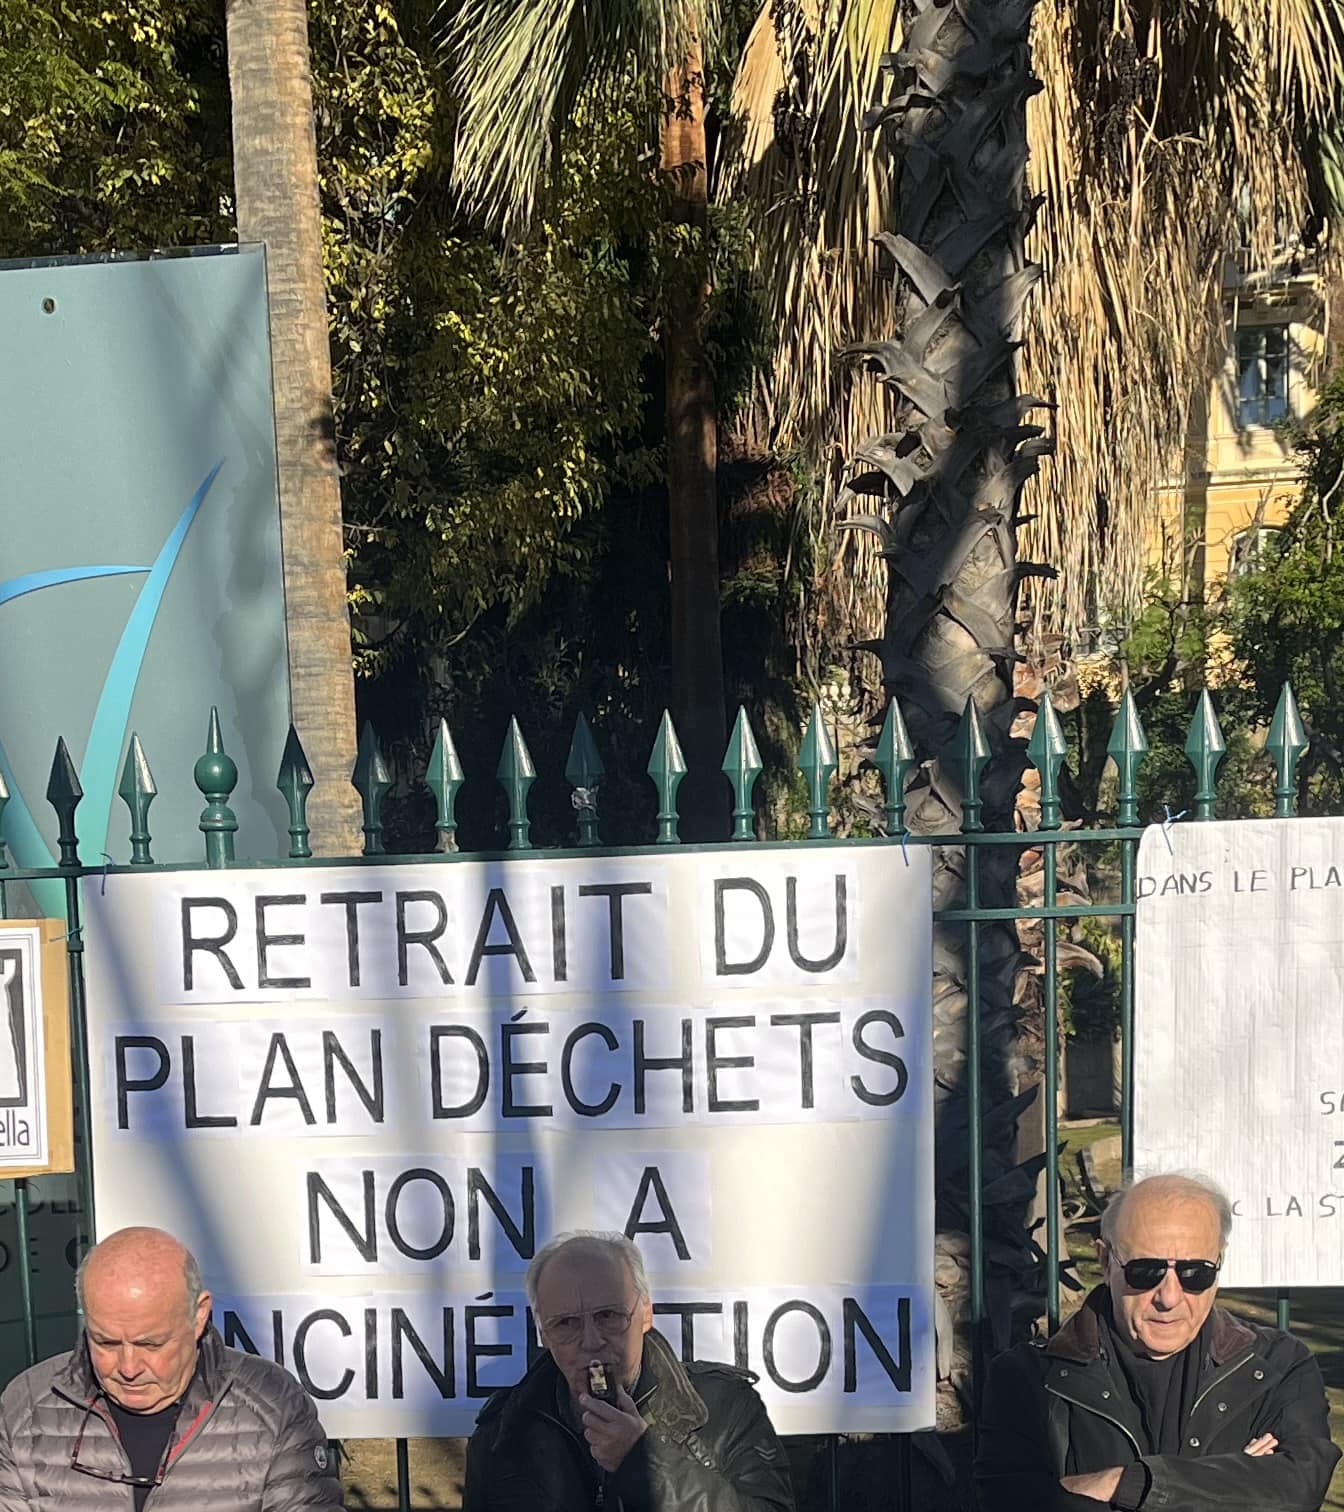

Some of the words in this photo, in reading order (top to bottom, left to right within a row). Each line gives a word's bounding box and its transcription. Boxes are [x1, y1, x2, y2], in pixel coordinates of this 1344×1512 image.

[181, 882, 652, 991] RETRAIT
[713, 874, 847, 977] DU
[1135, 870, 1212, 899] DANS
[1233, 869, 1268, 893] LE
[114, 1029, 384, 1130] PLAN
[431, 1006, 909, 1119] DÉCHETS
[307, 1165, 534, 1265] NON
[624, 1166, 690, 1261] A
[1266, 1196, 1304, 1218] LA
